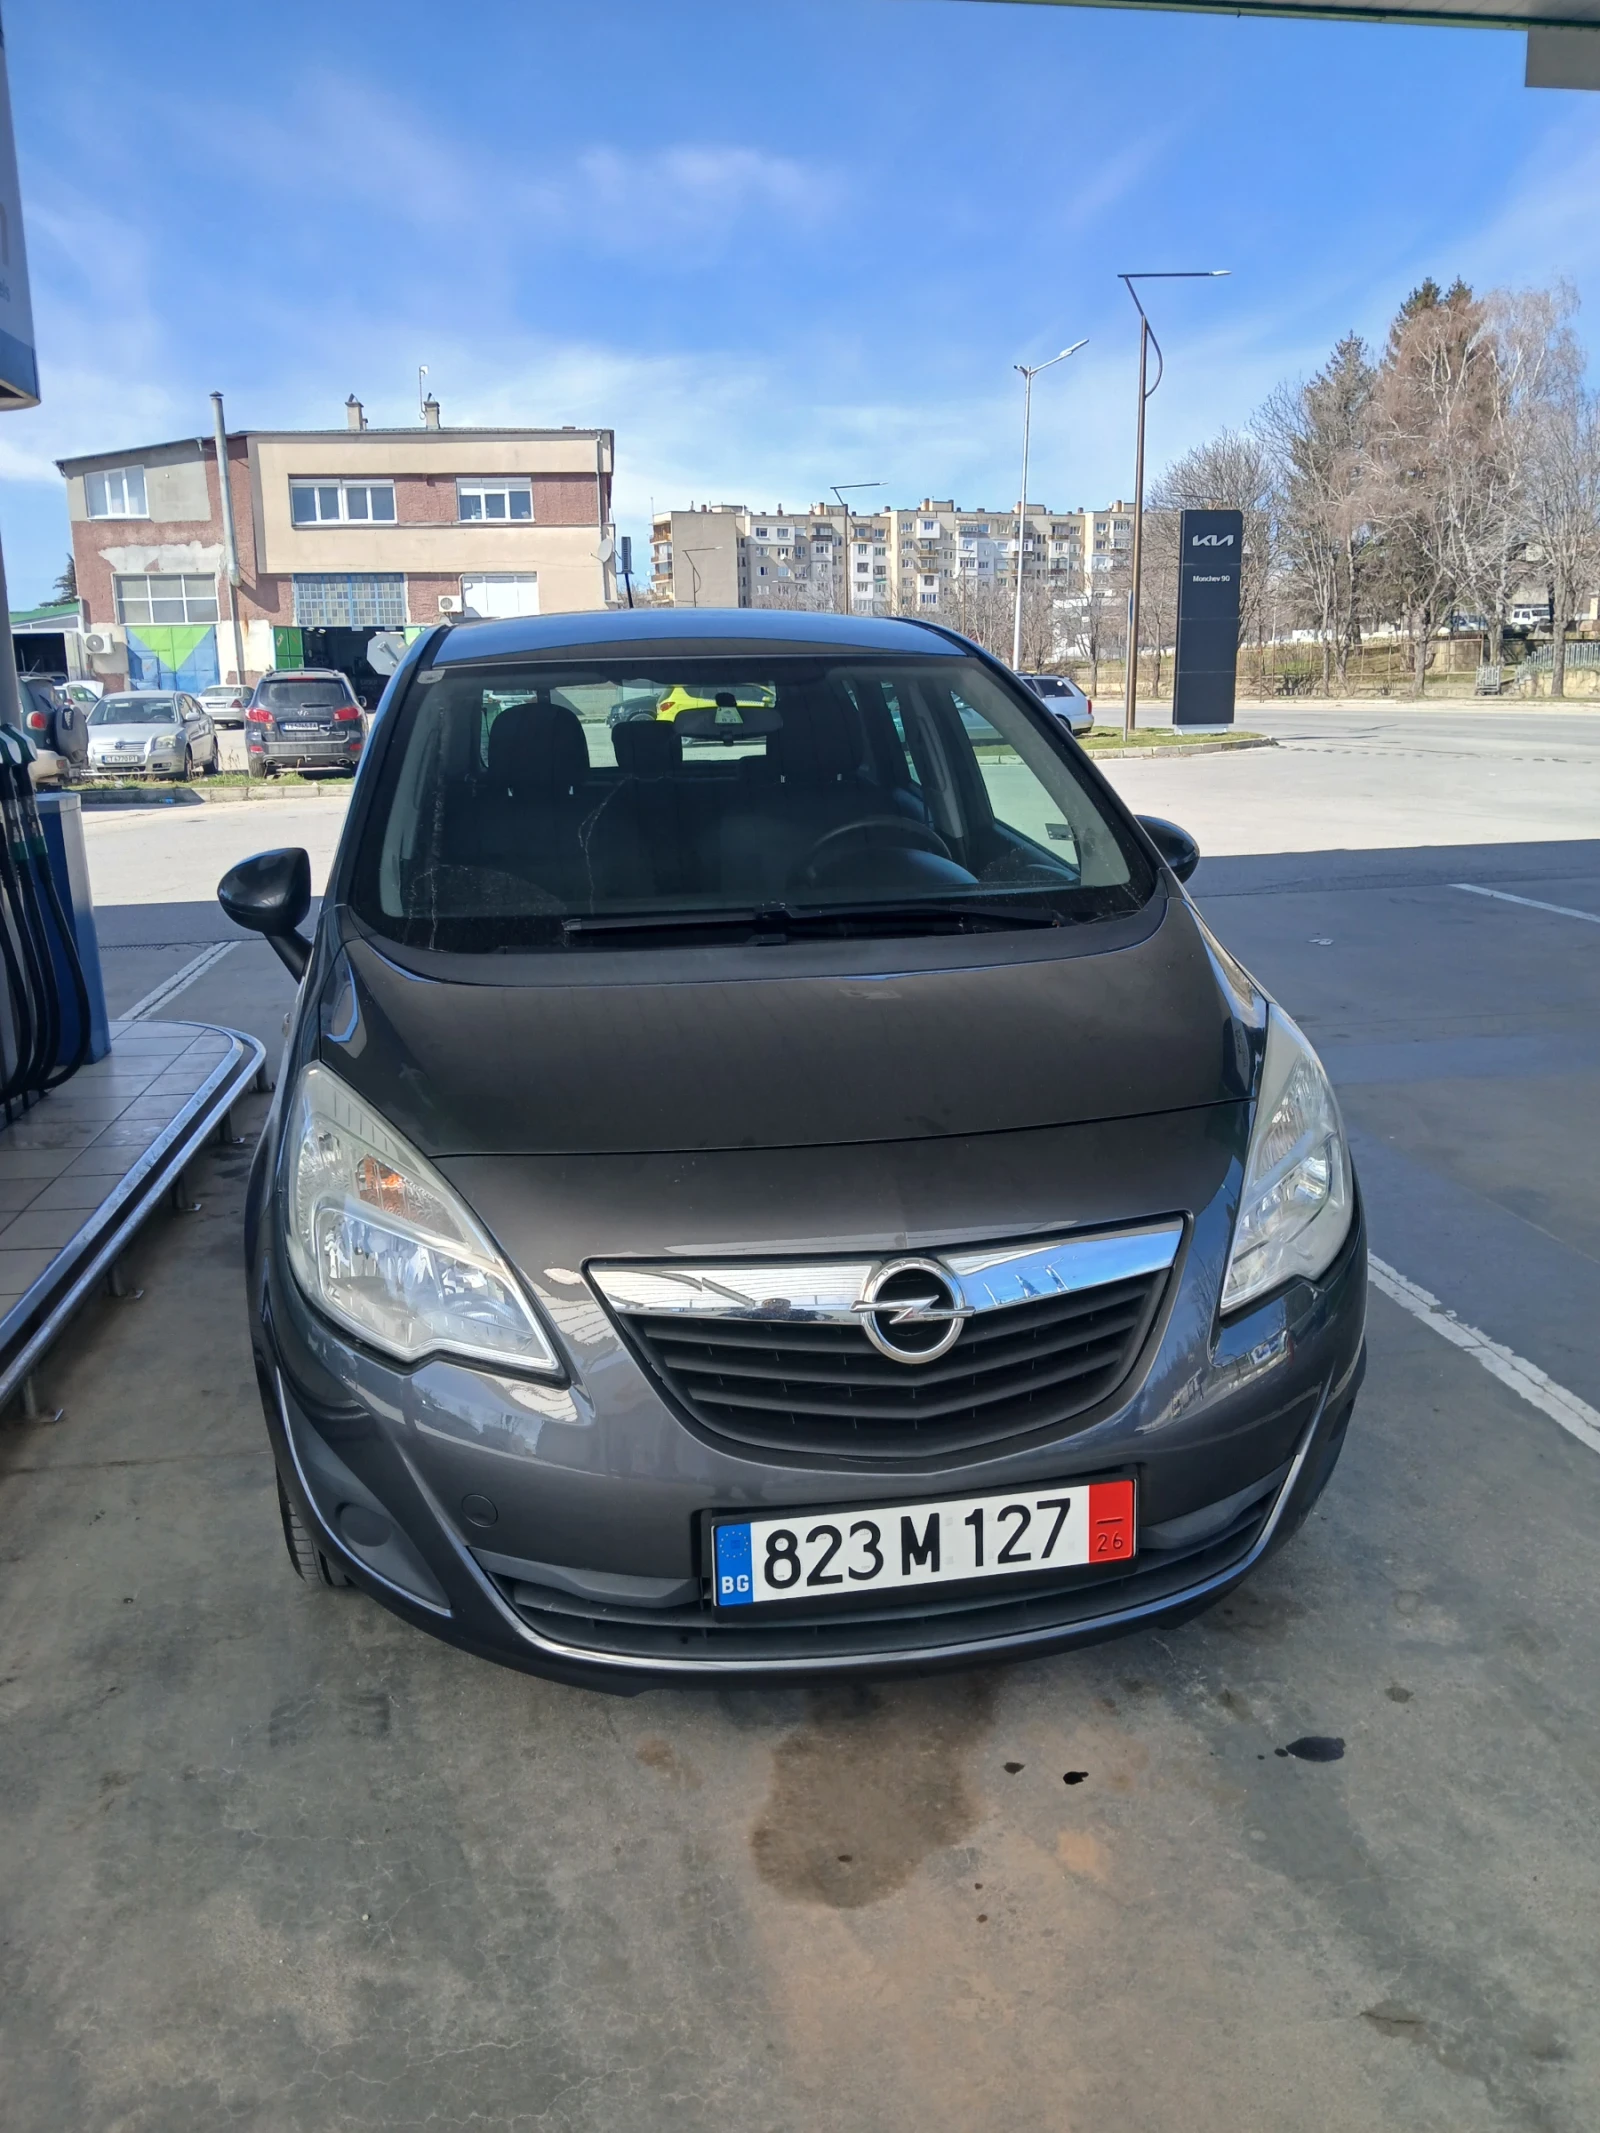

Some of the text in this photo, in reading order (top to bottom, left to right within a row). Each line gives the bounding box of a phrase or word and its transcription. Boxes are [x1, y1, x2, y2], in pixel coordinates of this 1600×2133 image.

[1192, 534, 1235, 546] KIA
[763, 1497, 1072, 1589] 823 M 127
[1096, 1530, 1124, 1553] 26
[722, 1575, 750, 1594] BG
